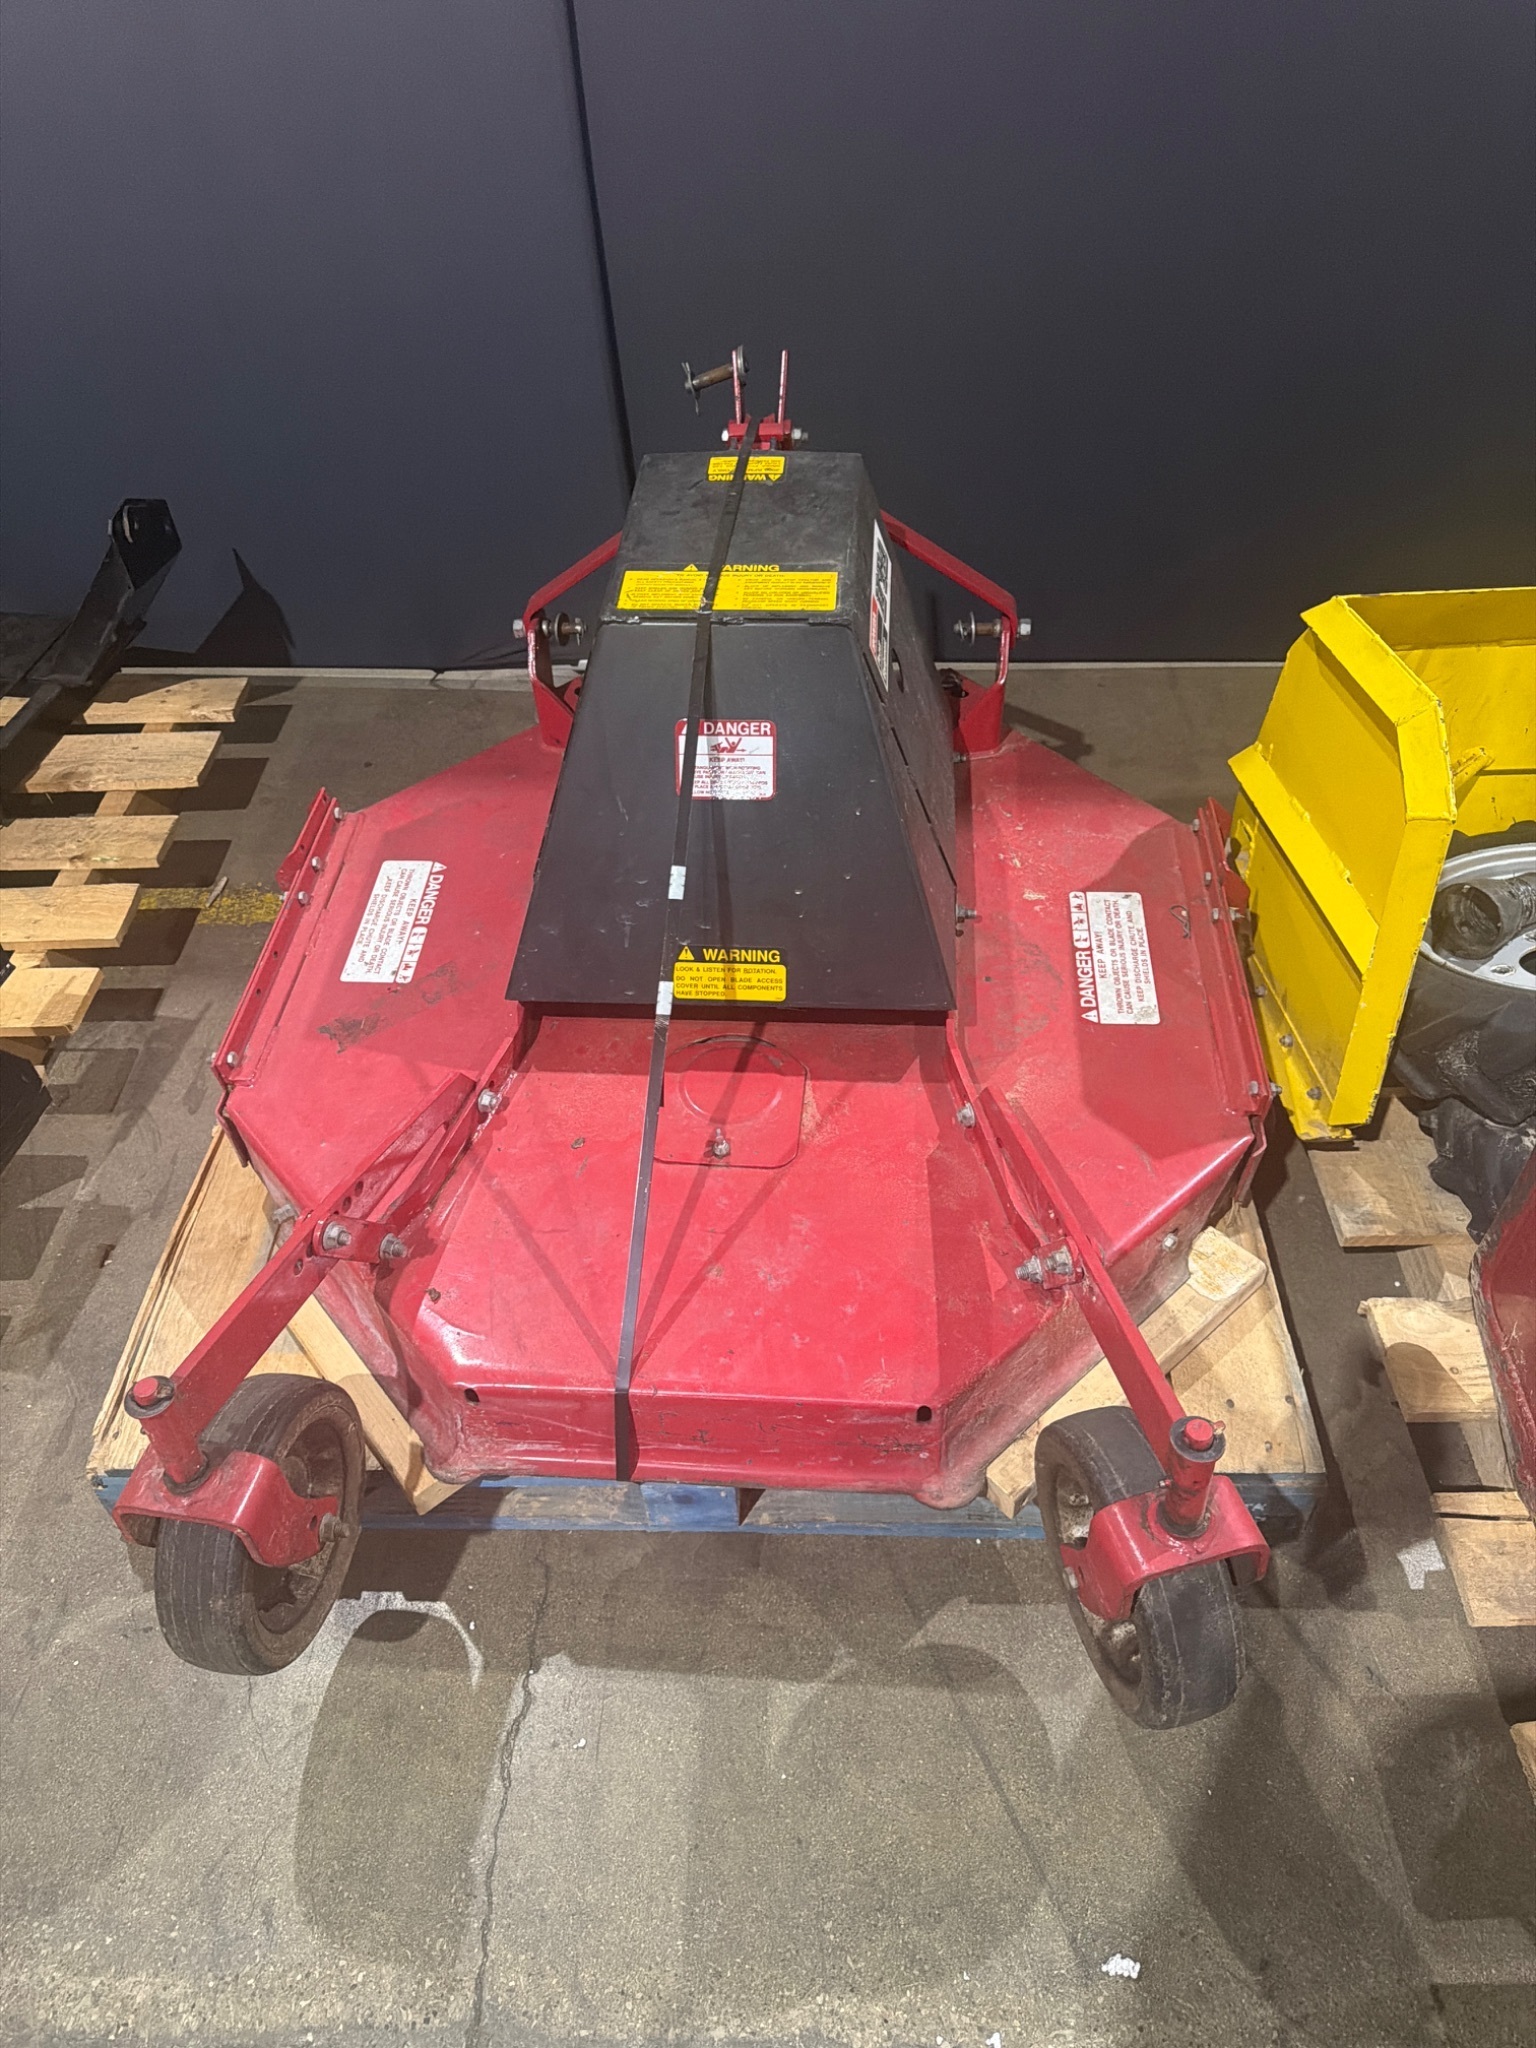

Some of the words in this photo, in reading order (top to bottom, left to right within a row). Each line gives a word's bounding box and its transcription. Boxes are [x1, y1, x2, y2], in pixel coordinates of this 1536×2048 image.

[721, 564, 780, 572] ARNING
[703, 722, 772, 736] DANGER
[393, 880, 403, 896] CAUSE
[403, 868, 414, 889] THROWN
[368, 893, 379, 915] SHIELDS
[372, 894, 387, 925] DISCHARGE
[384, 899, 396, 921] SERIOUS
[394, 893, 406, 915] OBJECTS
[406, 899, 417, 916] KEEP
[415, 874, 444, 924] DANGER
[1104, 899, 1113, 924] CONTACT
[364, 928, 375, 946] CHUTE
[377, 924, 388, 942] INJURY
[384, 928, 394, 945] BLADE
[1094, 931, 1104, 954] AWAY!
[1117, 930, 1125, 950] INJURY
[374, 948, 387, 974] CONTACT
[702, 948, 781, 963] WARNING
[1111, 948, 1117, 956] OR
[1098, 959, 1107, 978] KEEP
[1112, 959, 1120, 985] OBJECTS
[1120, 953, 1128, 976] SERIOUS
[1132, 948, 1142, 982] DISCHARGE
[1142, 959, 1150, 983] SHIELDS
[1076, 950, 1096, 1007] DANGER
[1123, 980, 1131, 998] CAUSE
[1116, 988, 1124, 1013] THROWN
